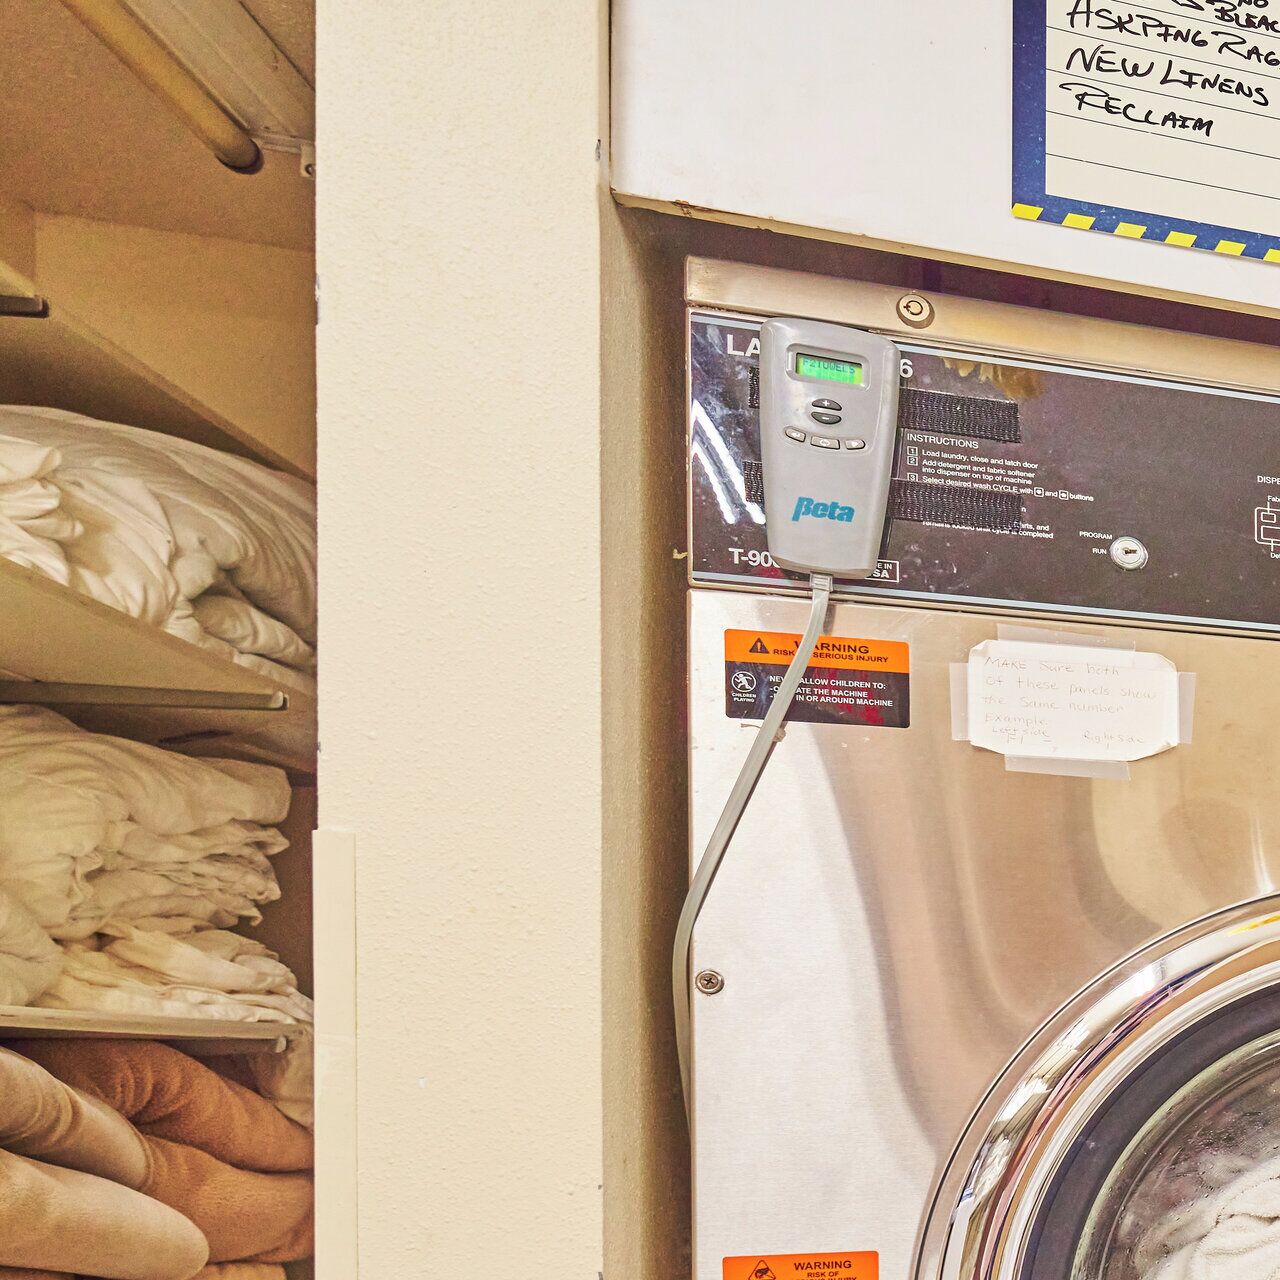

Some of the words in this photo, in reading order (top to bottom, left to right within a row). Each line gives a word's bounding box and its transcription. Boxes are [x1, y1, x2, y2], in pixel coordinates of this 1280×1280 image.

[1066, 44, 1154, 77] NEW
[1160, 60, 1269, 107] LINENS
[1059, 82, 1213, 136] RECLAIM
[907, 433, 979, 449] INSTRUCTIONS
[922, 466, 936, 474] into
[937, 468, 970, 480] dispenser
[982, 472, 994, 482] top
[995, 473, 1002, 481] of
[1003, 475, 1032, 485] machine
[1019, 529, 1054, 540] completed
[1079, 531, 1113, 540] PROGRAM
[1092, 548, 1107, 556] RUN
[813, 651, 854, 661] SERIOUS
[856, 655, 889, 663] INJURY
[984, 656, 1027, 669] MAKE
[1087, 663, 1119, 676] both
[820, 696, 855, 704] AROUND
[856, 698, 893, 707] MACHINE
[794, 1261, 852, 1271] WARNING
